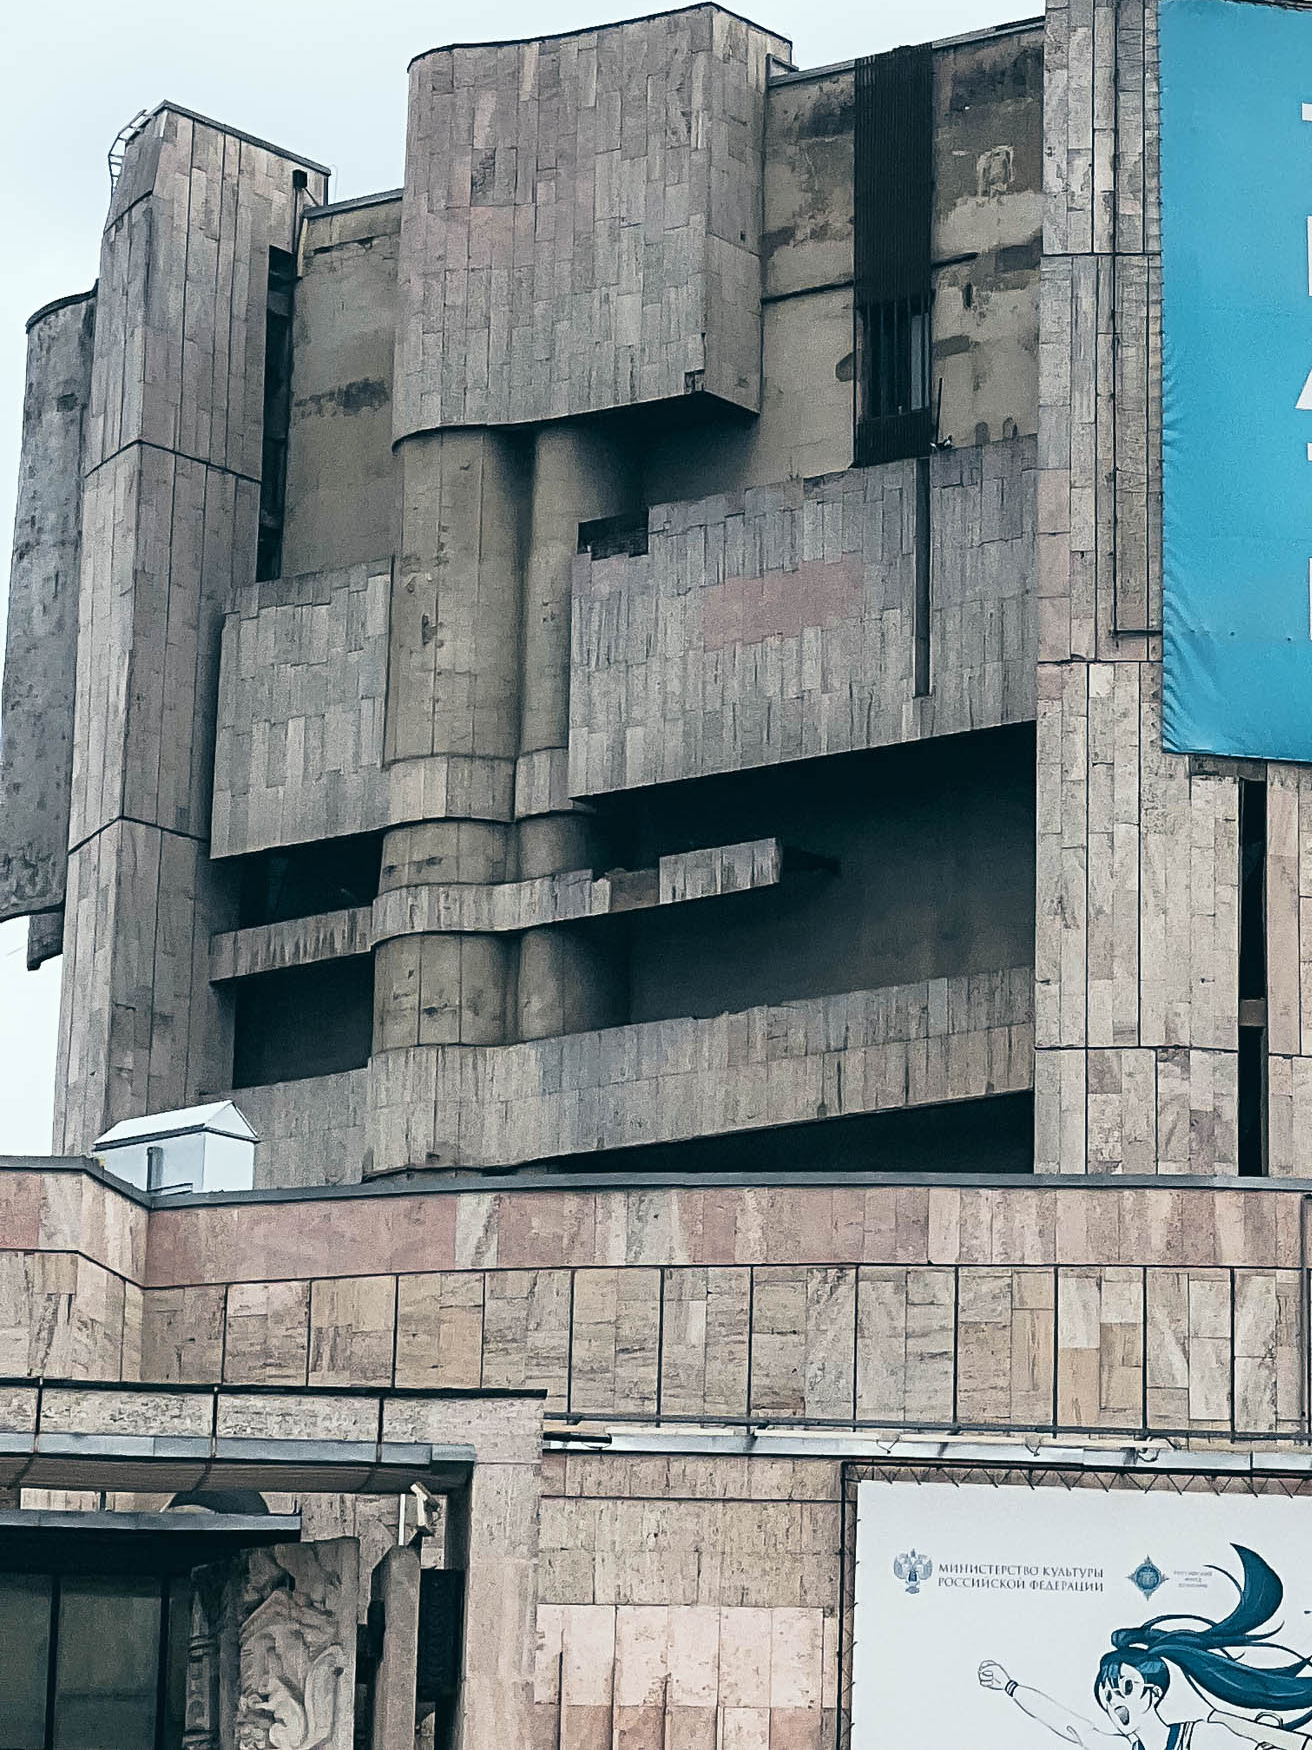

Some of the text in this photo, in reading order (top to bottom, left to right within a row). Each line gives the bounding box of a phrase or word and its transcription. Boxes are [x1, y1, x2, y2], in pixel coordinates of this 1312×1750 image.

[938, 1563, 1103, 1579] МИНИСТЕРСТВО КУЛЬТУРЫ
[938, 1577, 1103, 1592] РОССИЙСКОЙ ФЕДЕРАЦИИ
